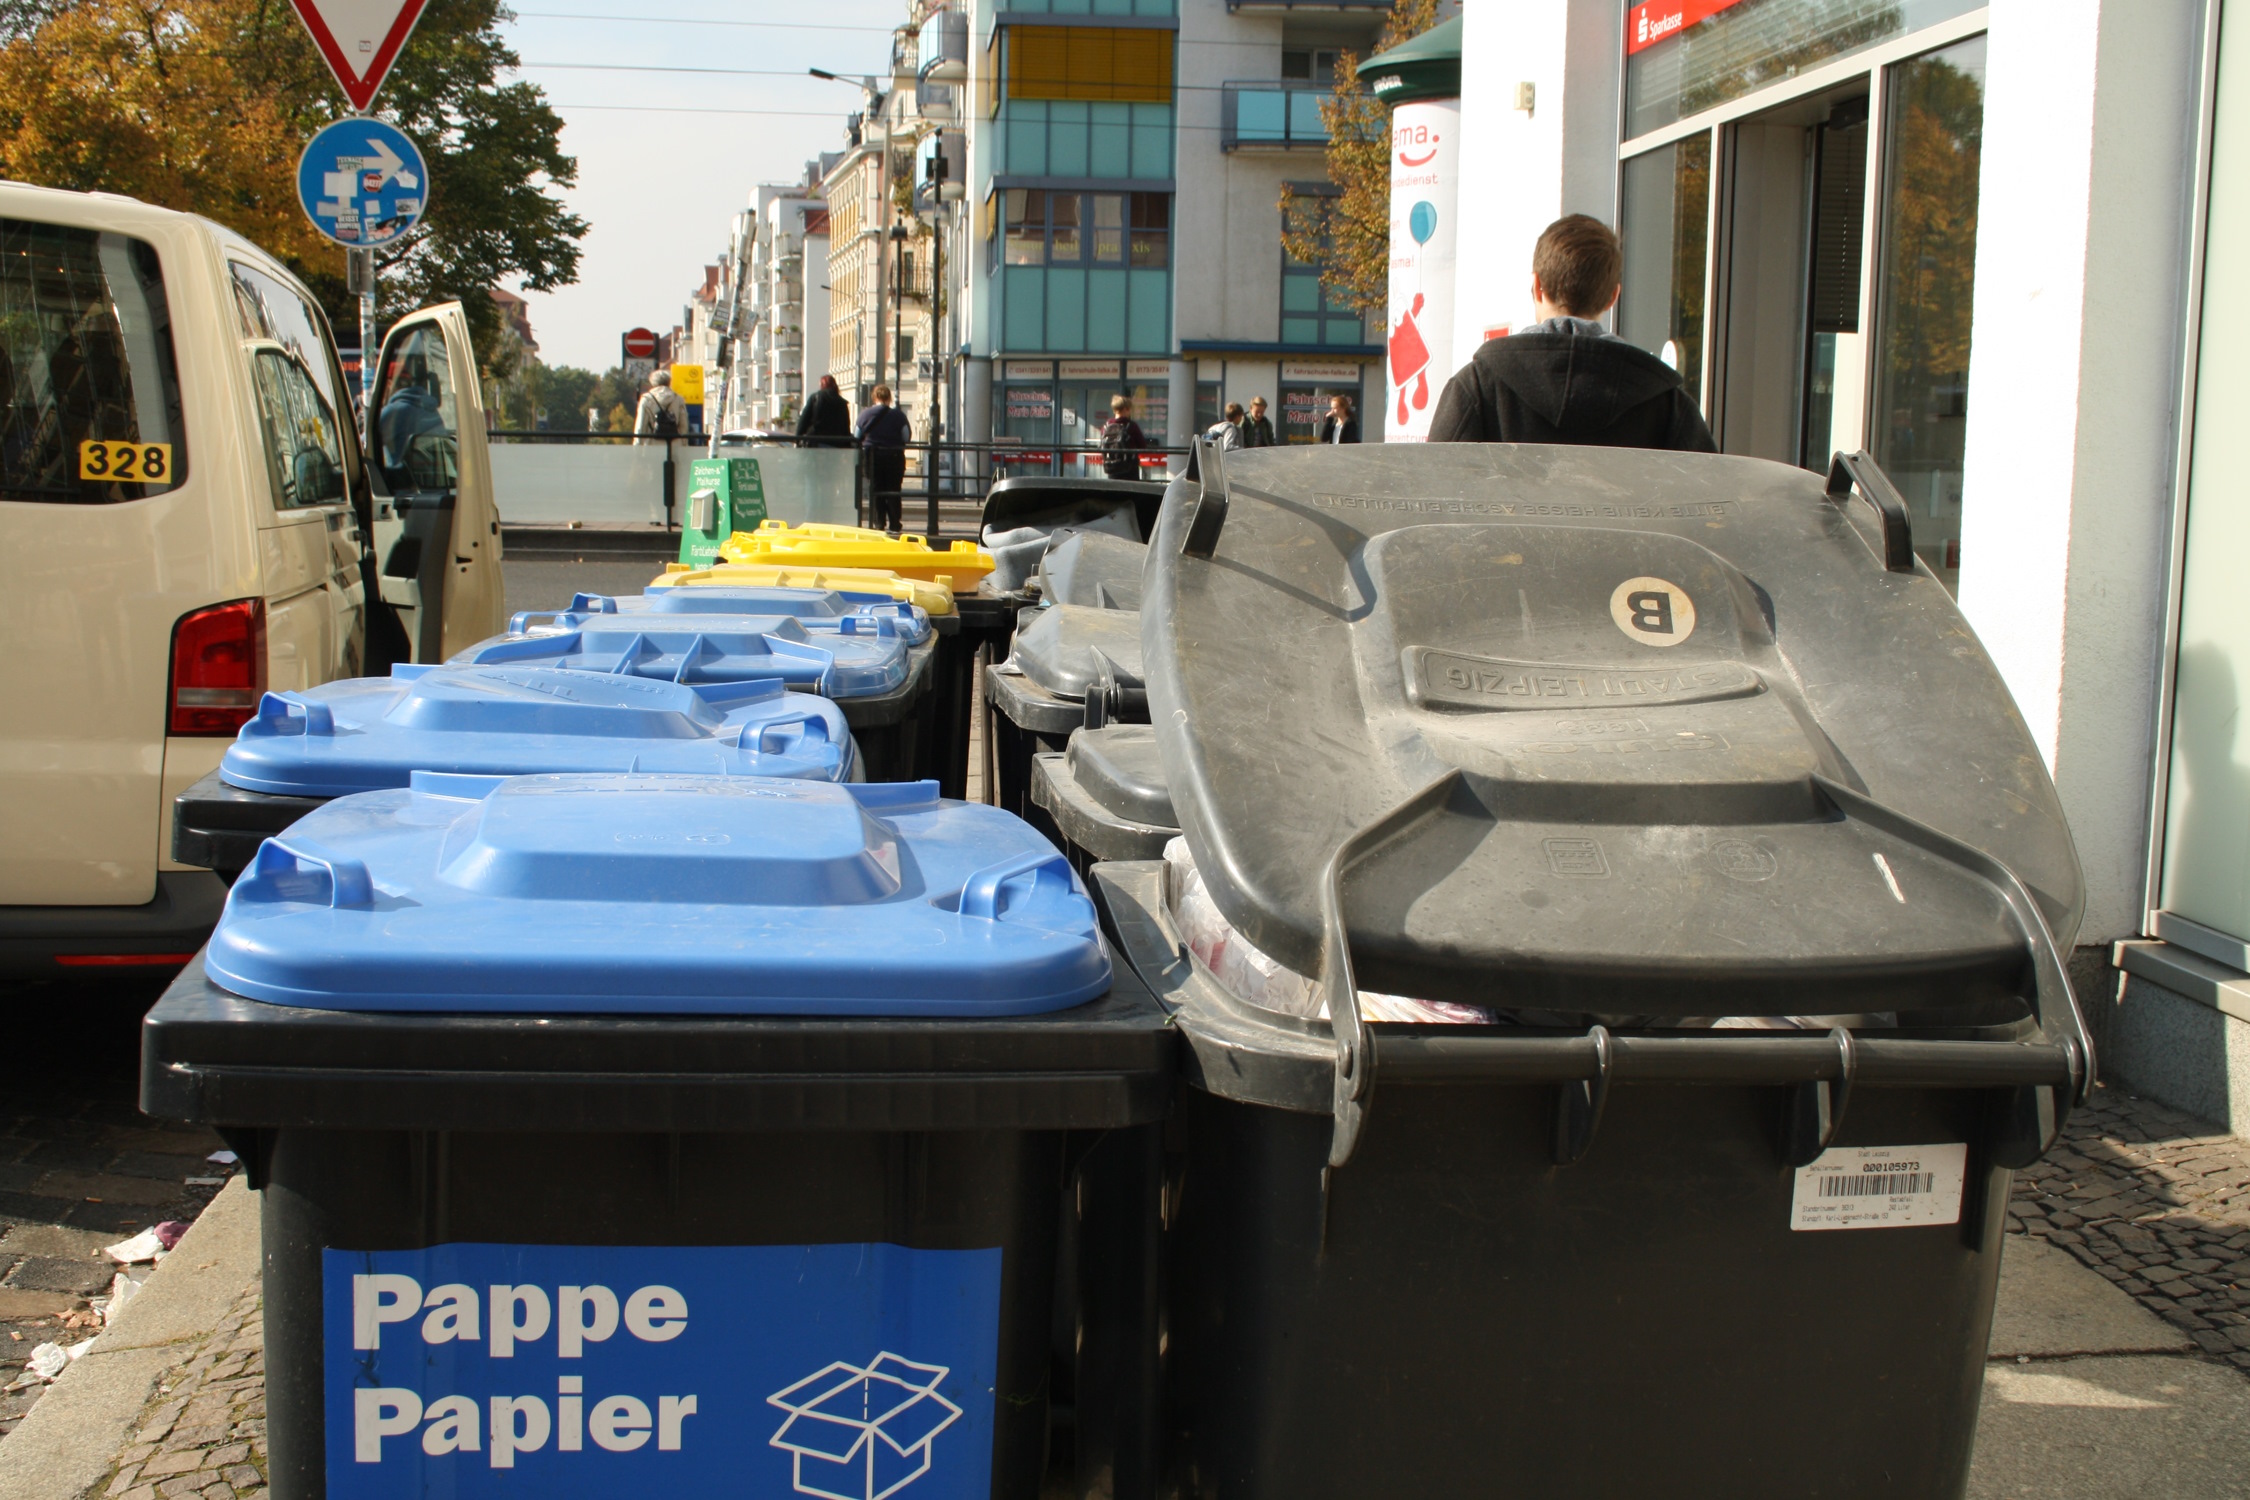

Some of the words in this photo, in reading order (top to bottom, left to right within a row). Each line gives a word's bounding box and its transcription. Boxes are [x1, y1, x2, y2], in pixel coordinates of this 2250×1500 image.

[1650, 12, 1682, 40] Sparkasse
[1098, 243, 1118, 254] pra
[1132, 240, 1151, 253] xis
[1293, 368, 1357, 376] fahrschule-falke.de
[1287, 410, 1320, 423] Mario
[86, 444, 166, 479] 328
[1449, 500, 1516, 516] ASCHE
[1525, 502, 1598, 517] HEISSE
[1603, 502, 1664, 517] KEINE
[1669, 503, 1725, 518] BITTE
[1626, 590, 1674, 635] B
[1445, 665, 1590, 699] LEIPZIG
[1600, 671, 1721, 697] STADT
[1863, 1162, 1919, 1173] 000105973
[353, 1273, 689, 1358] Pappe
[354, 1375, 698, 1469] Papier
